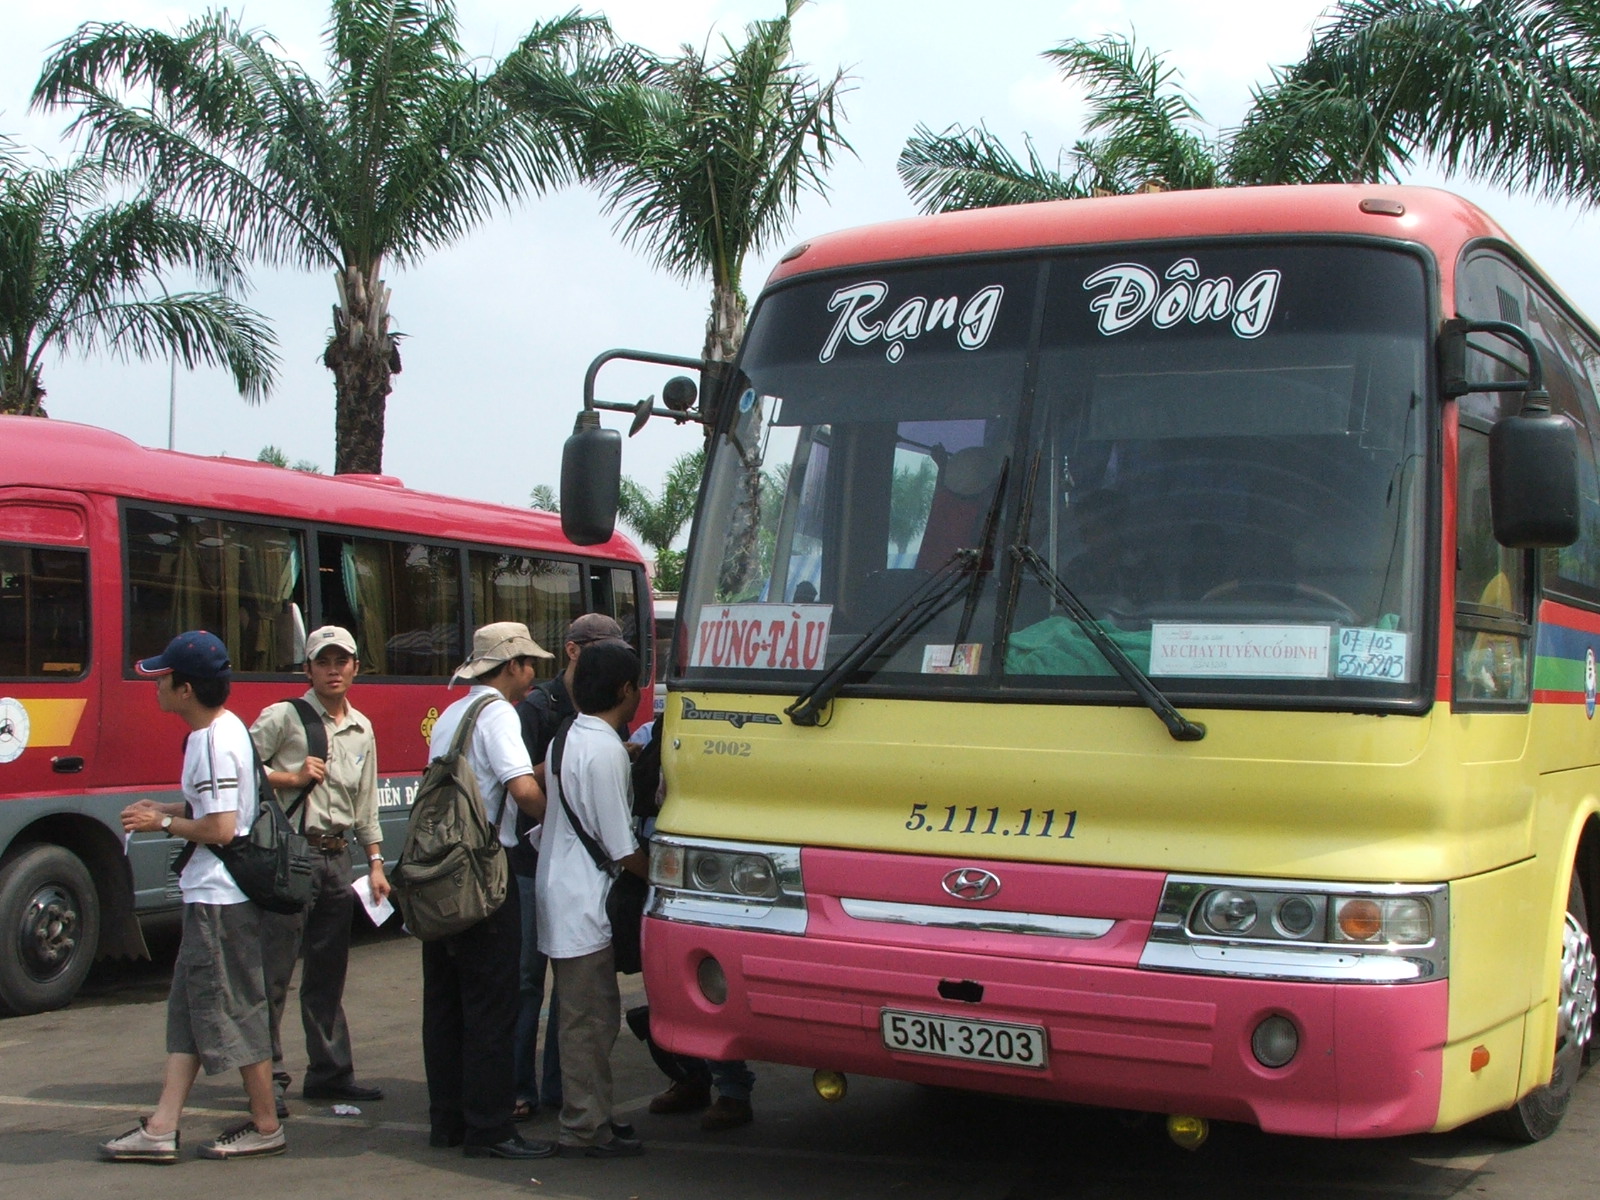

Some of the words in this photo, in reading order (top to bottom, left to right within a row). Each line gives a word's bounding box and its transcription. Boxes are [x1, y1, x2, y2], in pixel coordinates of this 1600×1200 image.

[819, 280, 1004, 363] Rạng
[1082, 258, 1281, 339] Đông
[1161, 644, 1178, 658] XE
[683, 697, 780, 727] POWERTEC
[704, 740, 752, 757] 2002
[377, 778, 401, 806] IỀN
[905, 803, 1077, 839] 5.111.111
[892, 1017, 1033, 1062] 53N-3203
